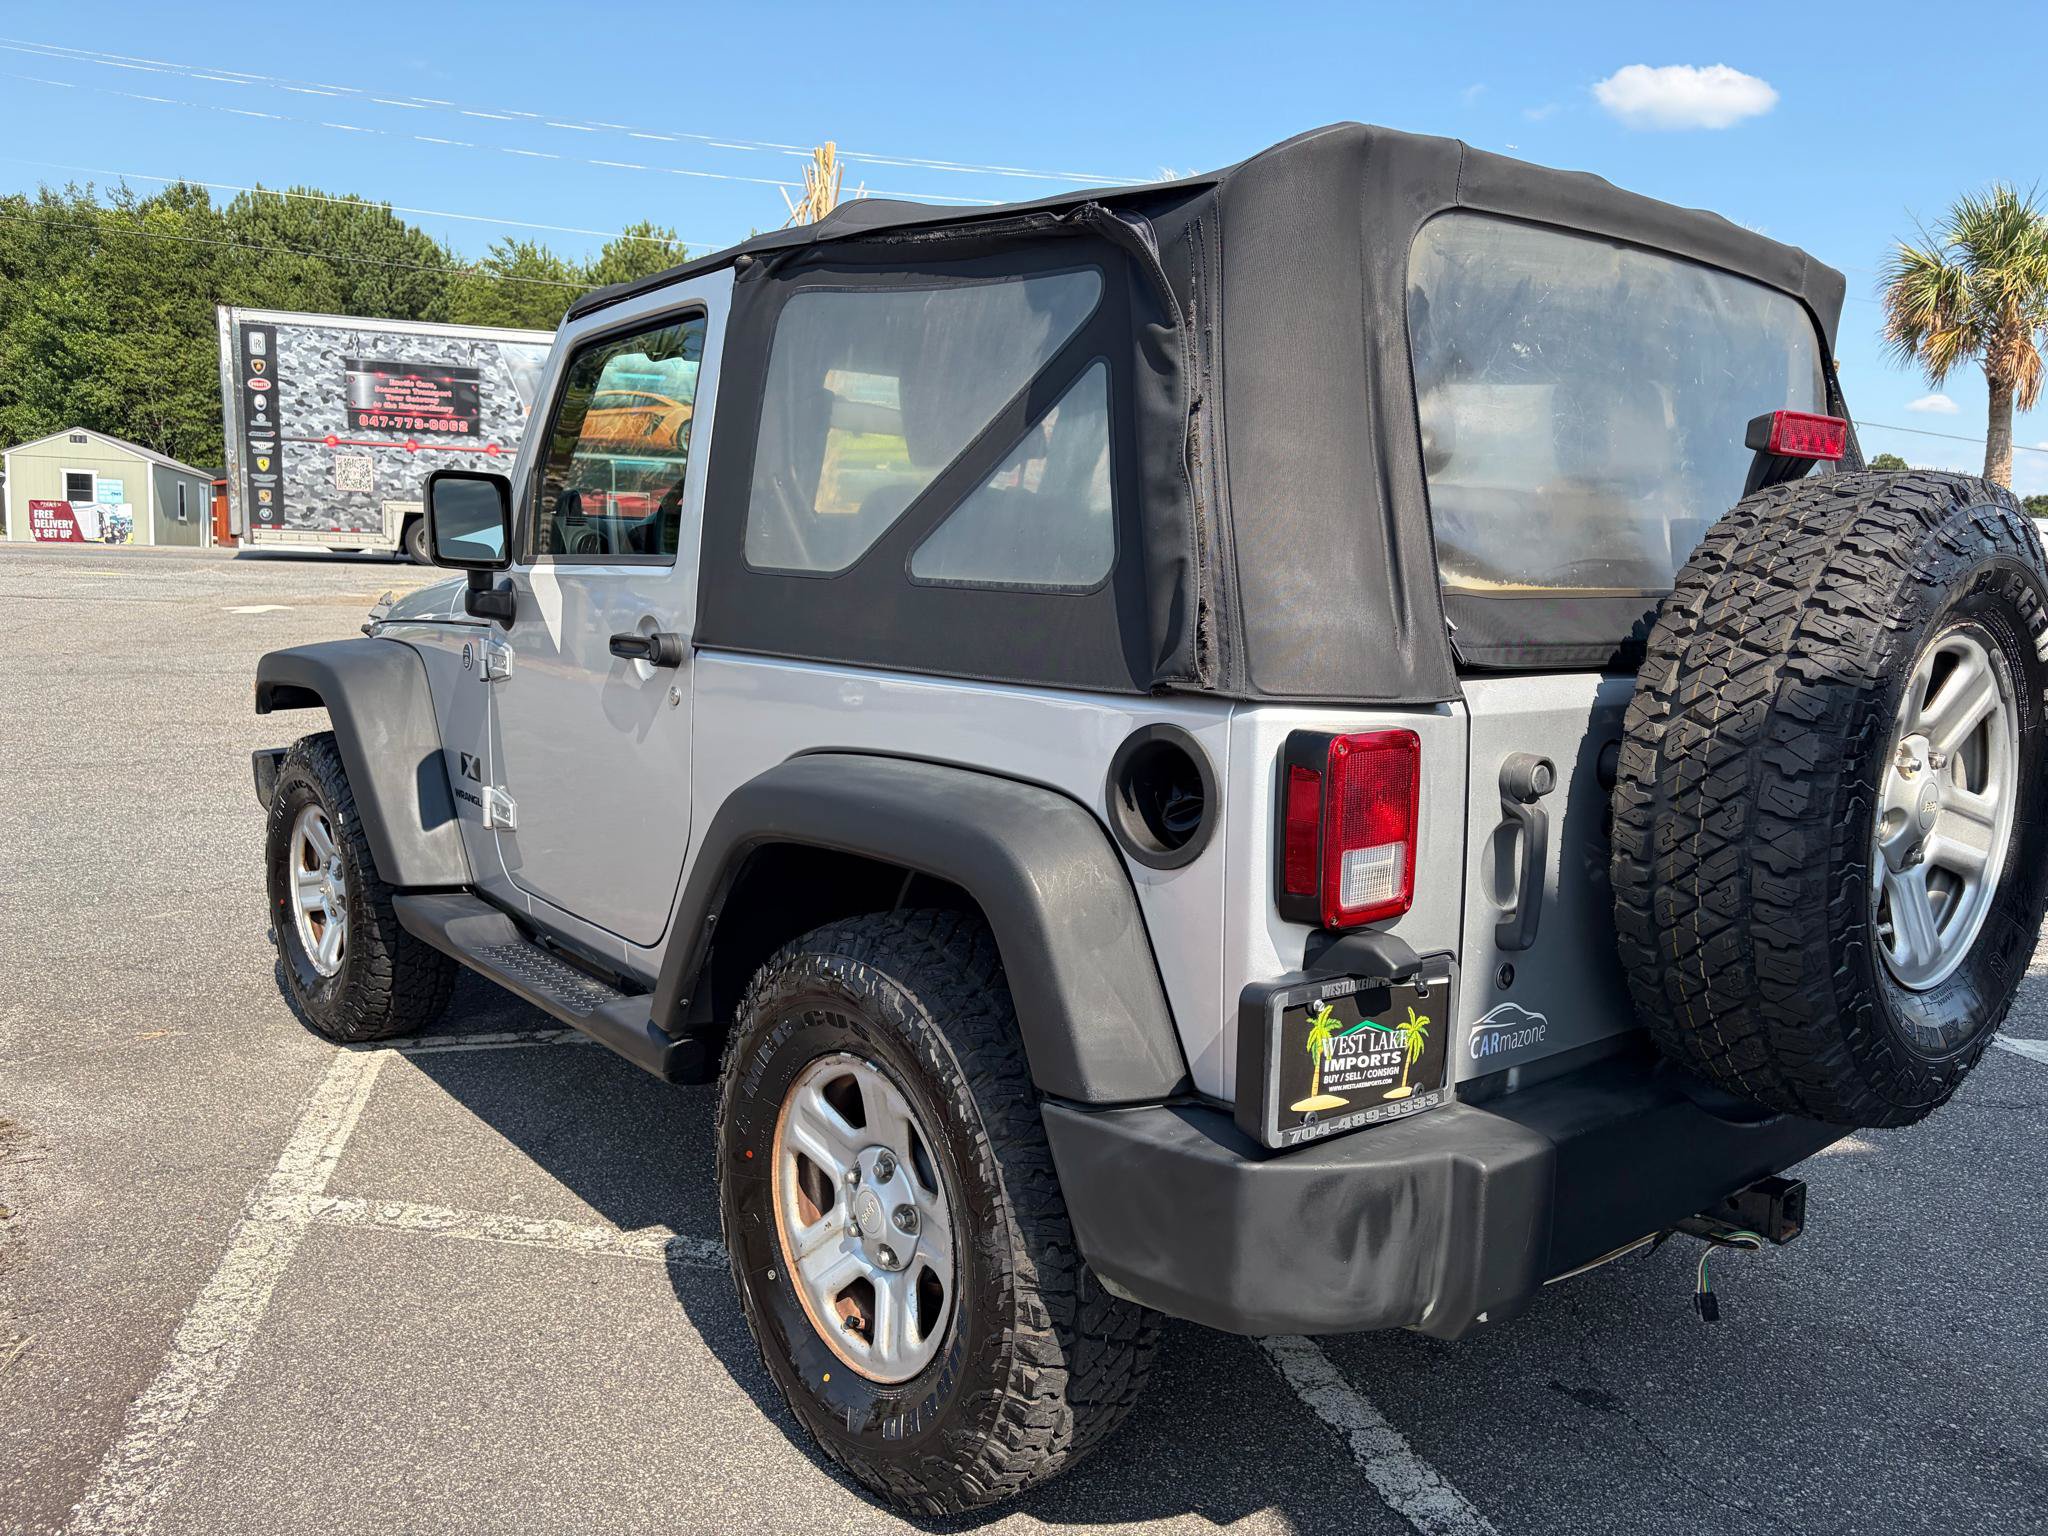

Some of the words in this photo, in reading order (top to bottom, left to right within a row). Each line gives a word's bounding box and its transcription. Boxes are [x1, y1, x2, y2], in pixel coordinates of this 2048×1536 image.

[33, 509, 54, 519] FREE
[34, 519, 74, 529] DELIVERY
[43, 529, 58, 538] SET
[60, 529, 72, 539] UP
[455, 787, 484, 808] WRANGL
[1322, 1033, 1366, 1058] WEST
[1369, 1029, 1409, 1052] LAKE
[1470, 1025, 1546, 1059] CARmazone
[1324, 1050, 1401, 1073] IMPORTS
[1323, 1073, 1339, 1085] BUY
[1345, 1071, 1361, 1082] SELL
[1367, 1065, 1400, 1079] CONSIGN
[1289, 1093, 1440, 1145] 704-489-9333
